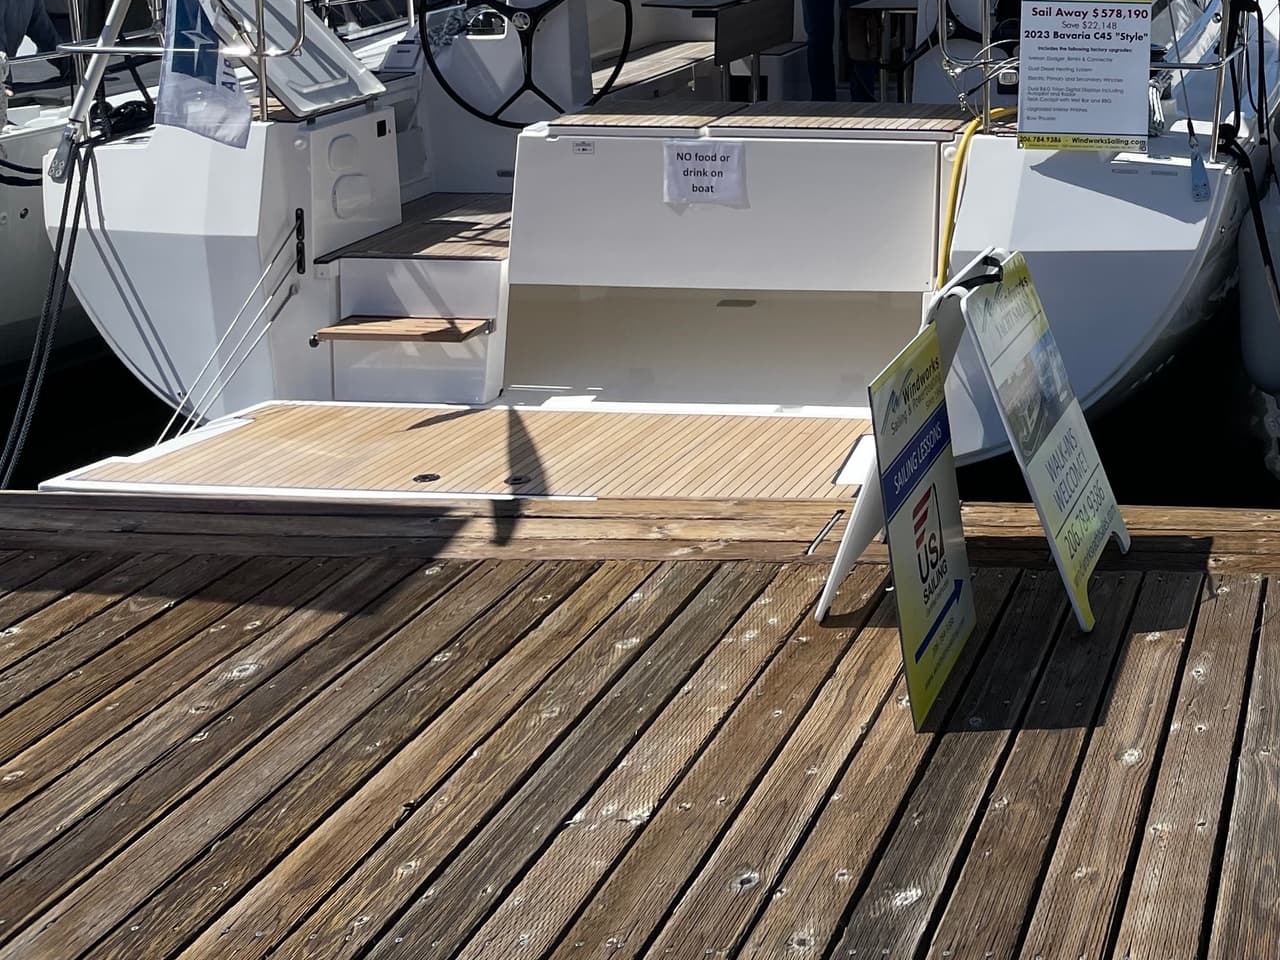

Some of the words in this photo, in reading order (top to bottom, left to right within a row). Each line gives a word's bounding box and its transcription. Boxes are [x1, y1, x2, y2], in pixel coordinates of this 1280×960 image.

[1024, 30, 1050, 40] 2023
[1053, 30, 1091, 40] Bavaria
[1094, 31, 1113, 41] C45
[1032, 7, 1052, 17] Sail
[1055, 8, 1089, 20] Away
[1062, 21, 1080, 29] Save
[676, 152, 692, 161] NO
[695, 152, 717, 162] food
[719, 154, 731, 162] or
[683, 168, 708, 177] drink
[710, 170, 724, 178] on
[692, 184, 714, 193] boat
[902, 357, 940, 406] Windworks
[893, 452, 919, 495] SAILING
[917, 421, 943, 465] LESSONS
[1045, 427, 1079, 483] WALK-INS
[1052, 447, 1091, 513] WELCOME!
[1063, 479, 1106, 561] 206.784.9386
[917, 532, 939, 585] US
[923, 559, 948, 605] SAILING
